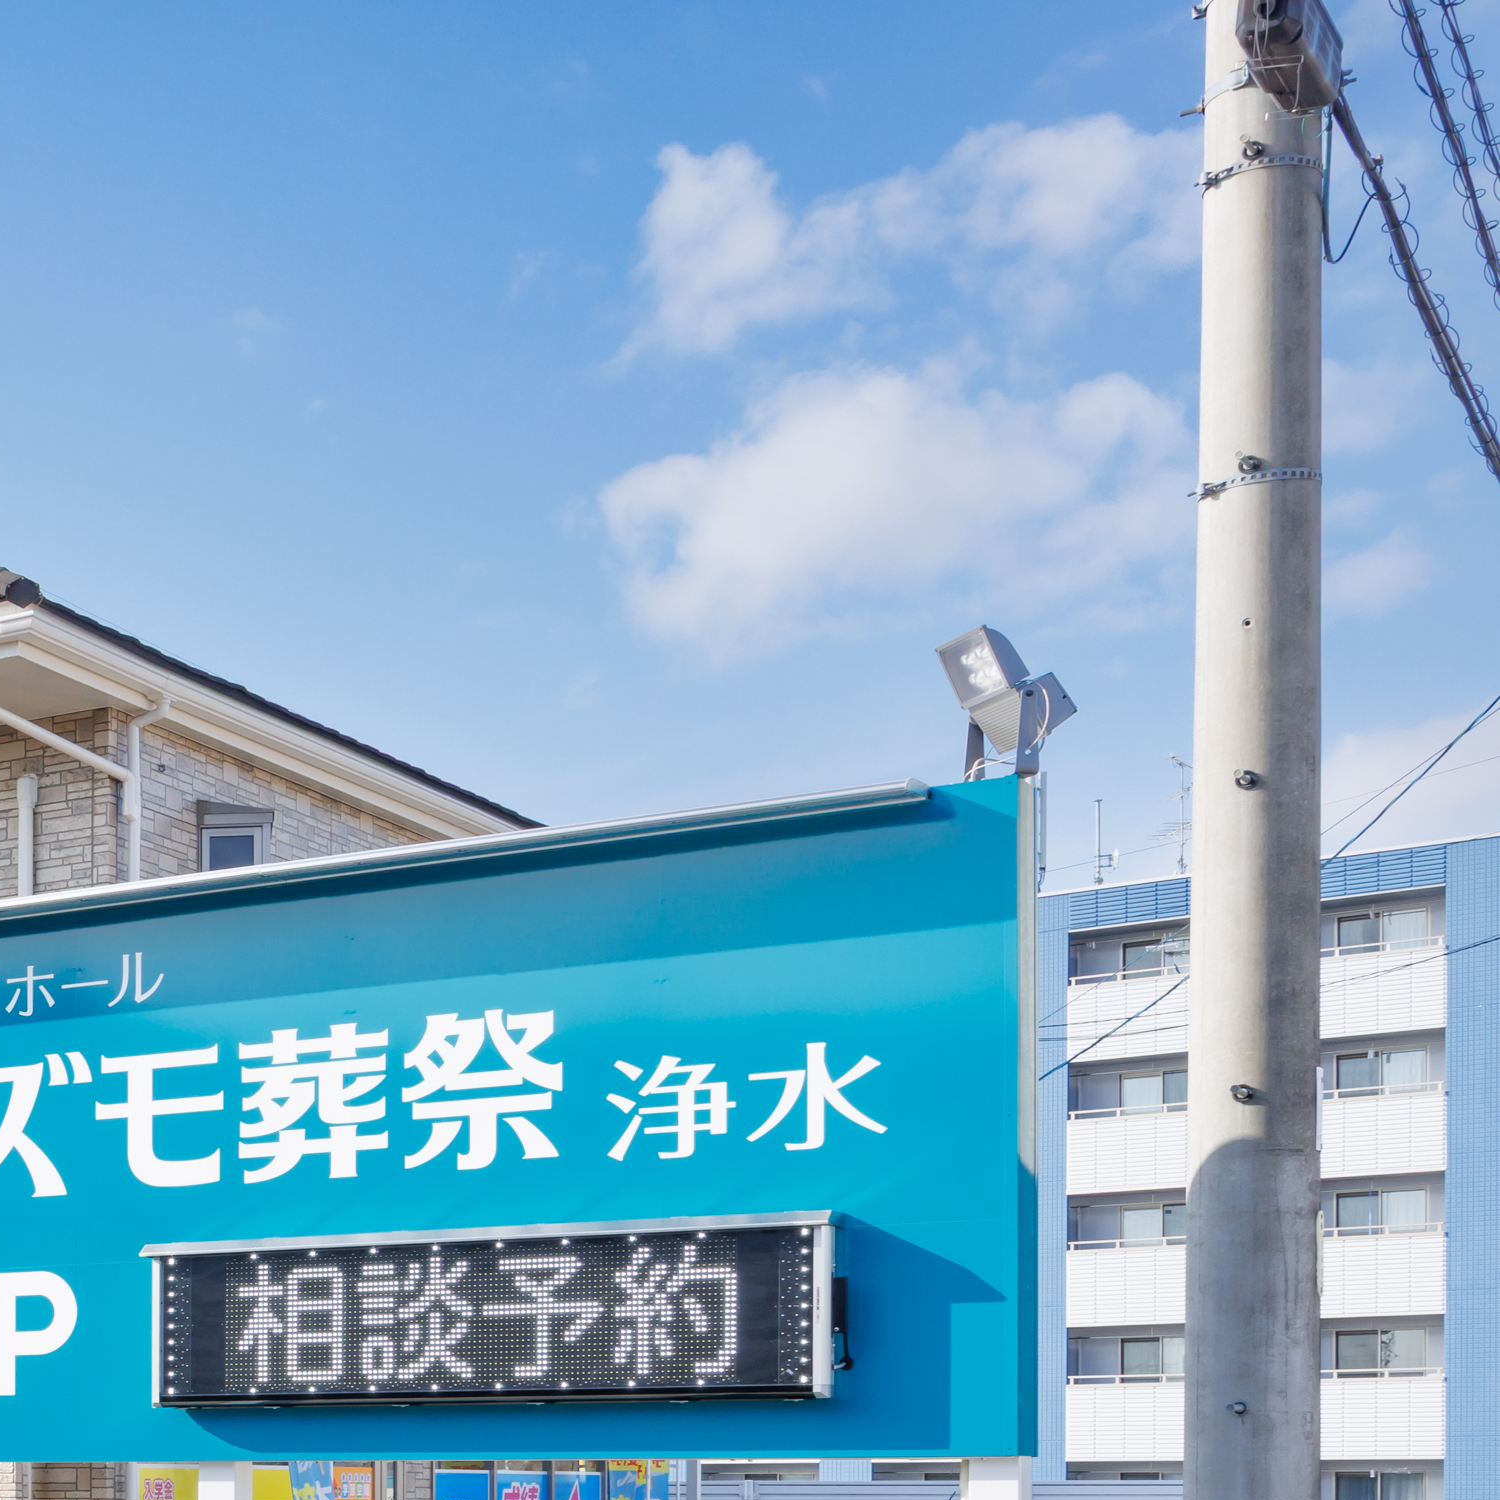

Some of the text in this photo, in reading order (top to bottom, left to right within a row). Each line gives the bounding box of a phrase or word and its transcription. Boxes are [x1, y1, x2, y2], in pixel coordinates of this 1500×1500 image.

[606, 1041, 888, 1162] 浄水
[237, 1244, 739, 1386] 相談予約
